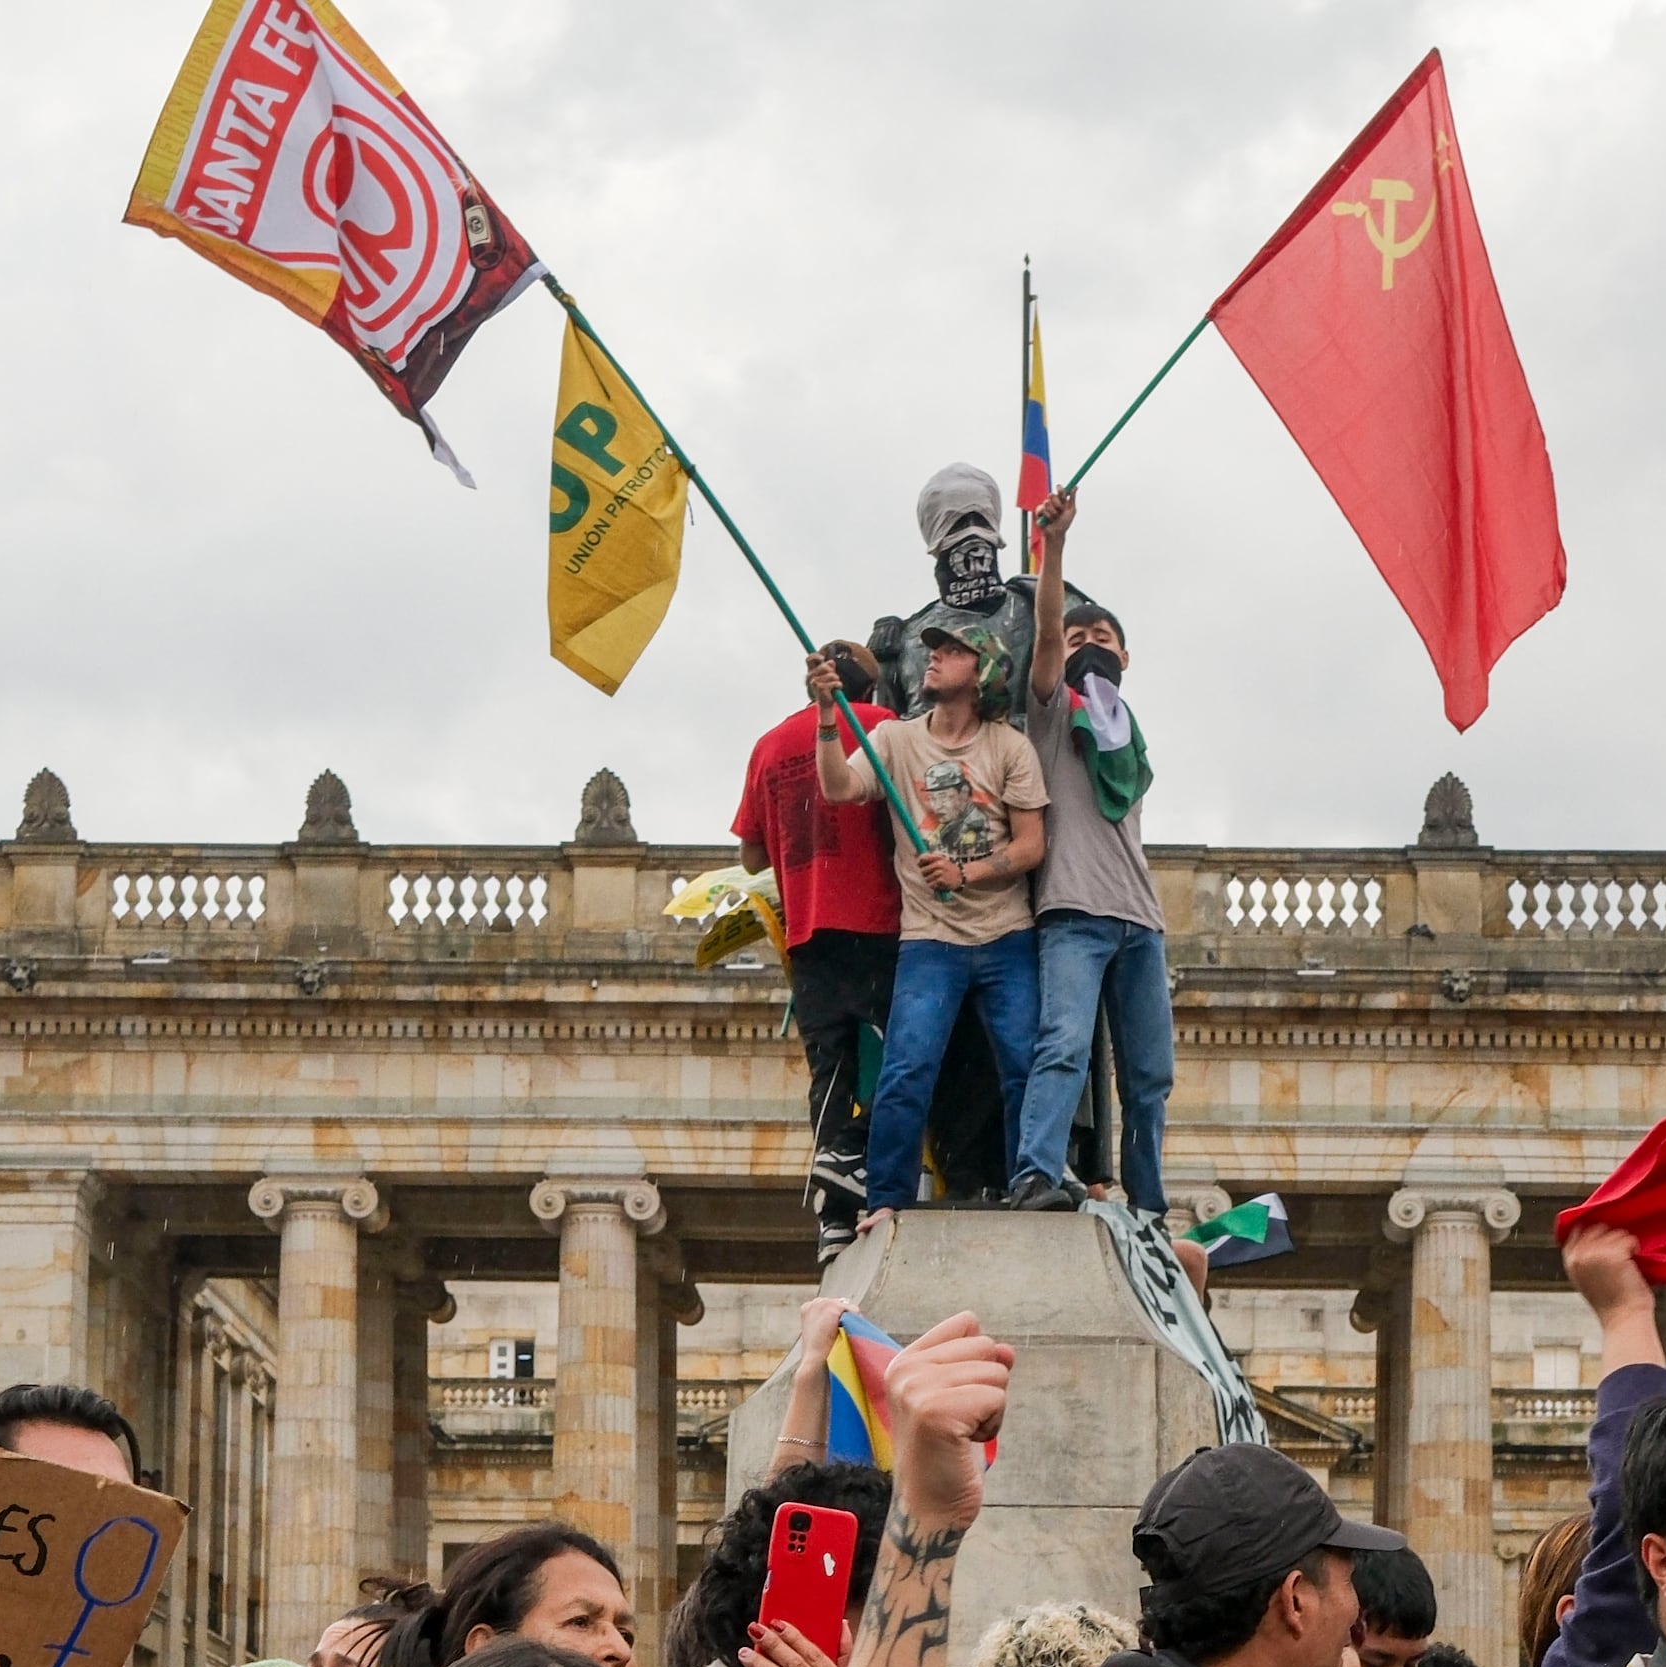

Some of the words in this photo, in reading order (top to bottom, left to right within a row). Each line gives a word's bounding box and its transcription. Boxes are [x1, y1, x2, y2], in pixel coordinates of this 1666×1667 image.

[183, 78, 289, 235] SANTA
[249, 0, 314, 76] FE
[564, 517, 611, 575] UNIÓN
[605, 441, 666, 519] PATRIÓTIC
